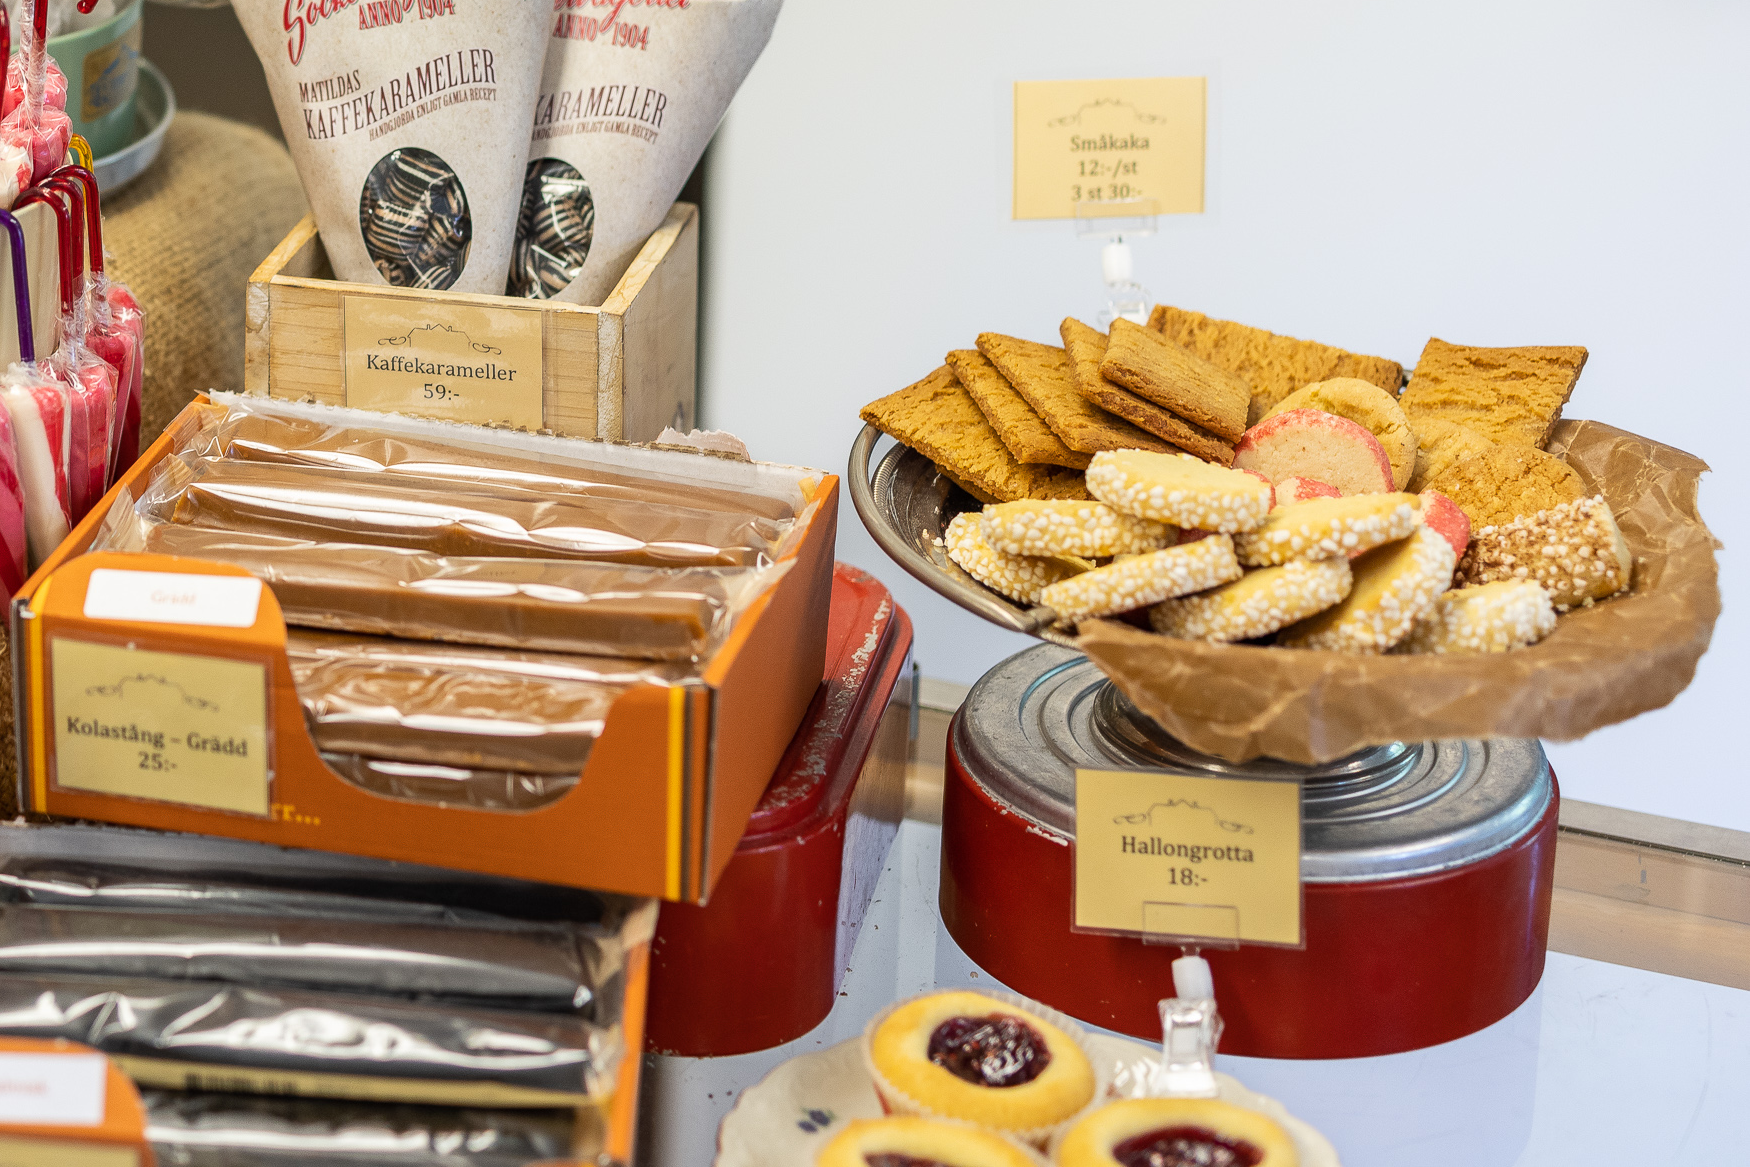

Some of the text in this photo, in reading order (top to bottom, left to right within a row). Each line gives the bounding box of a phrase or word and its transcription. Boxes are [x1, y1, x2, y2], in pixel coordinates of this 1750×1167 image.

[358, 0, 403, 31] ANNO
[553, 12, 650, 51] ANNO 1904
[298, 69, 361, 103] MATILDAS
[303, 48, 497, 140] KAFFEKARAMELLER
[416, 96, 442, 119] ENLIGT
[443, 89, 469, 108] GAMLA
[469, 87, 497, 102] RECEPT
[1070, 133, 1151, 152] Småkaka
[1079, 159, 1138, 179] 12:-/st
[1071, 183, 1143, 202] 3 st 30:-
[366, 353, 517, 381] Kaffekarameller
[423, 383, 460, 401] 59:-
[66, 715, 165, 749] Kolastång
[186, 732, 248, 758] Grädd
[138, 751, 178, 772] 25:-
[1121, 835, 1255, 863] Hallongrotta
[1167, 867, 1208, 887] 18:-
